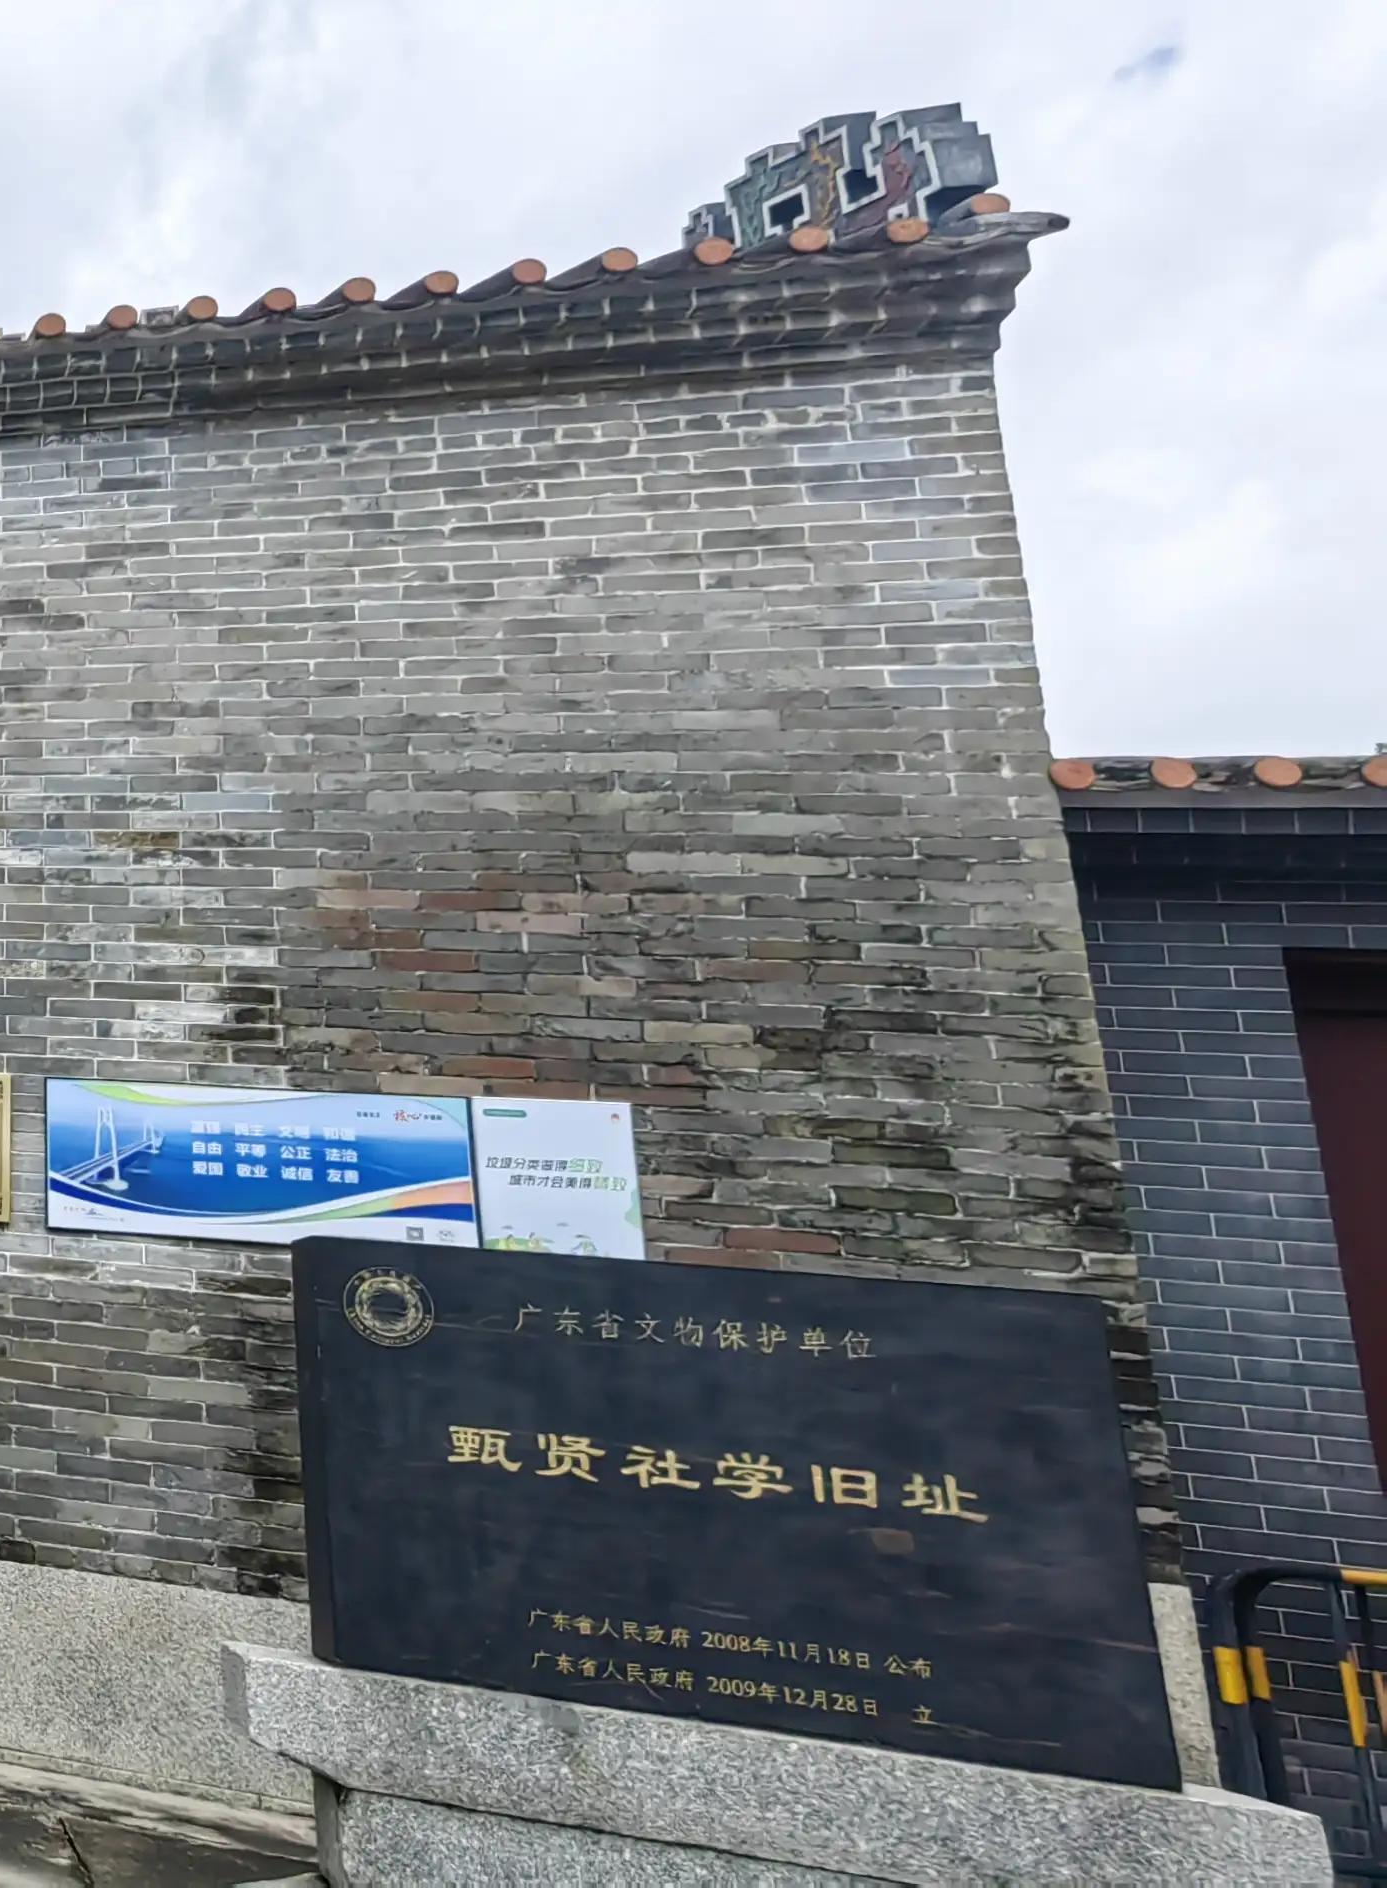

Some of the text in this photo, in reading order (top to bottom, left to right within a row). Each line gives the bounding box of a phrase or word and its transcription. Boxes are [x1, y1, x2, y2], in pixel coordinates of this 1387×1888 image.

[191, 1141, 359, 1163] 自由 平等 公正 法治
[192, 1161, 360, 1184] 爱国 敬业 诚信 友善
[513, 1302, 878, 1361] 广东省文物保护单位
[446, 1424, 990, 1524] 甄贤社学旧址
[528, 1608, 933, 1680] 广东省人民政府 2008年11月18日 公布
[531, 1650, 933, 1726] 广东省人民政府 2009年12月28日 立
